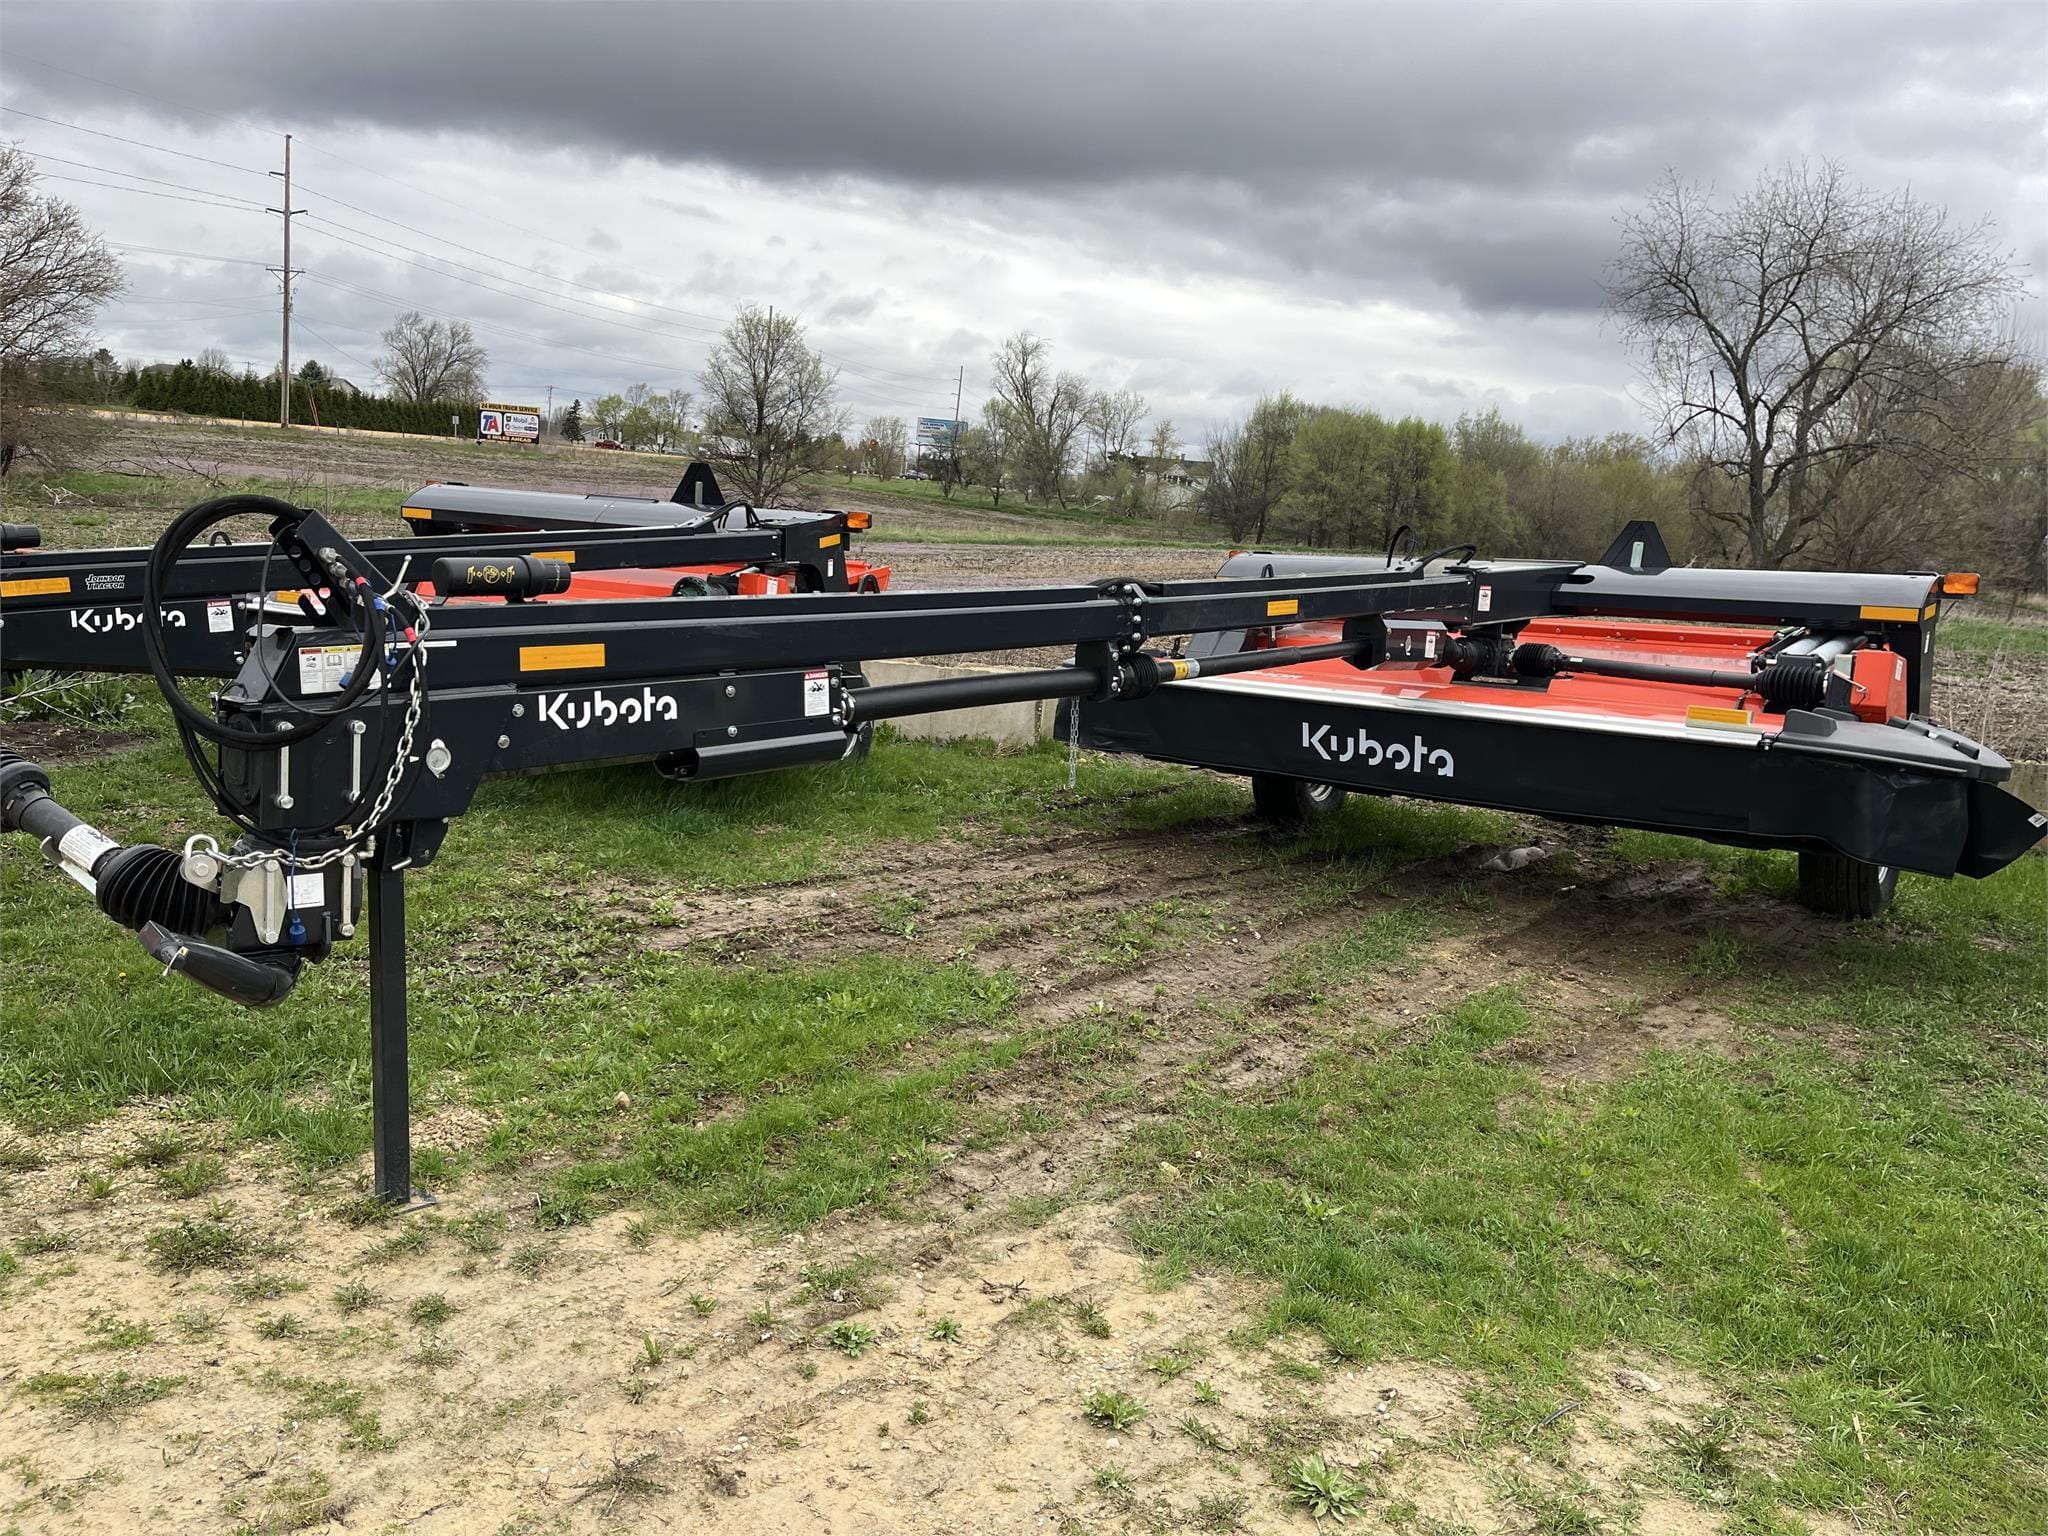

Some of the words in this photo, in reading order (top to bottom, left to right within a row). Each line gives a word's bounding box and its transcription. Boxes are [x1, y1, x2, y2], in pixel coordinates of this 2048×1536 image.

[483, 415, 499, 432] TA
[87, 581, 125, 590] TRACTOR
[70, 607, 187, 634] Kuba
[538, 686, 678, 730] Kubota
[1302, 721, 1454, 778] Kubota
